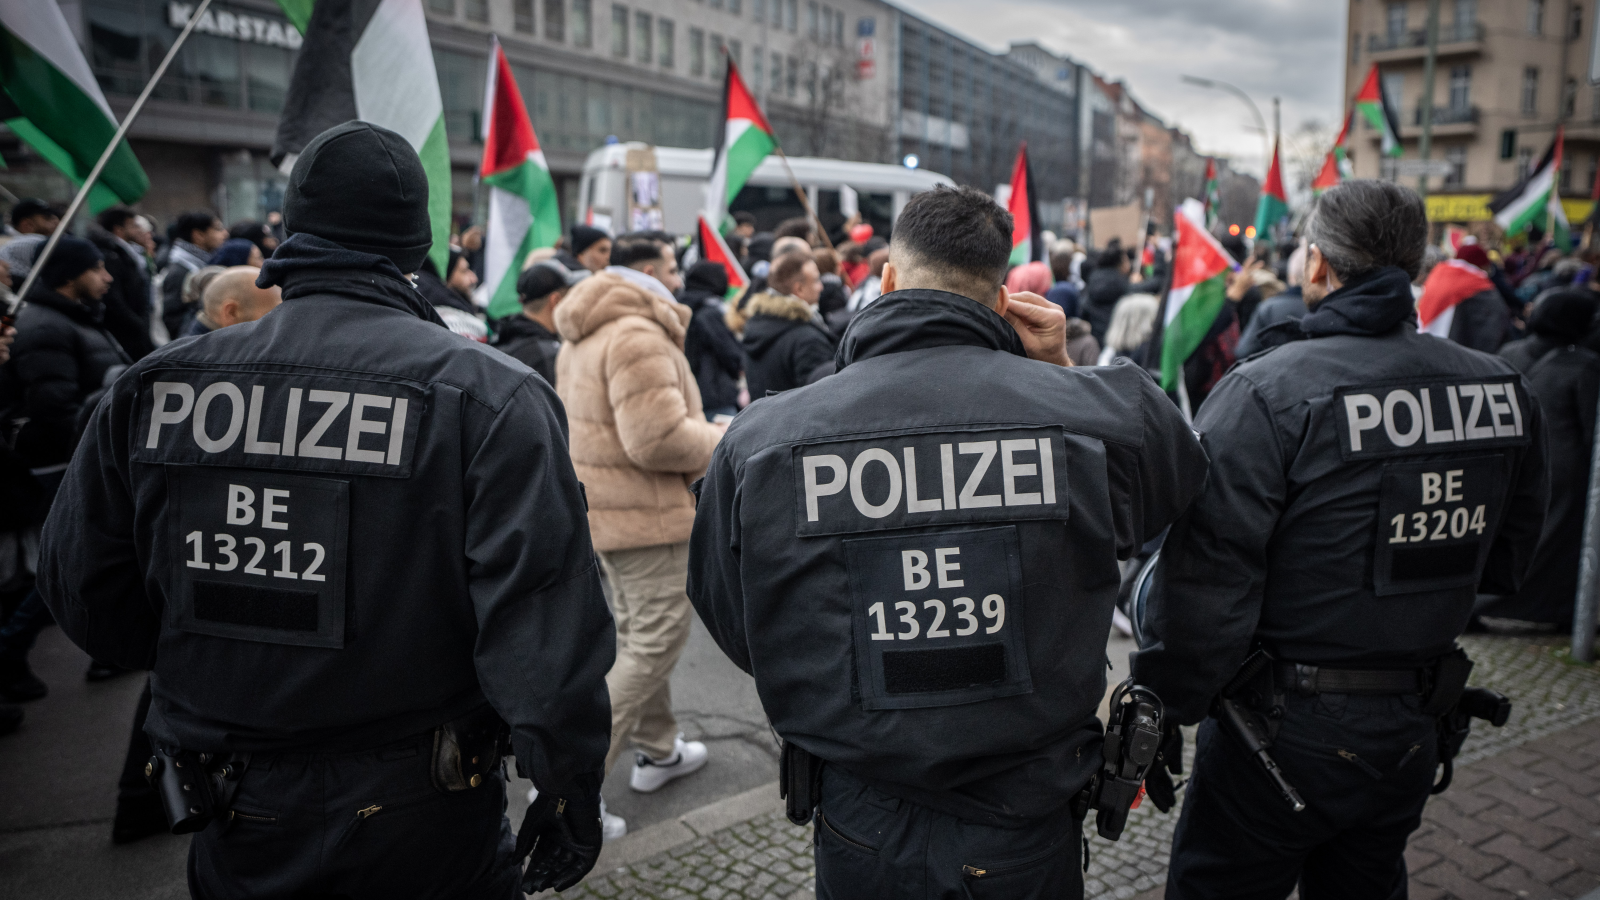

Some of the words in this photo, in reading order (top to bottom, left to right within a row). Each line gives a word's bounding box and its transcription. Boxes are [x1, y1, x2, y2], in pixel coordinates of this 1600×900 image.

[145, 381, 409, 466] POLIZEI
[1343, 382, 1524, 452] POLIZEI
[802, 437, 1057, 523] POLIZEI
[1421, 469, 1464, 505] BE
[226, 483, 290, 531] BE
[1389, 504, 1487, 544] 13204
[185, 530, 326, 582] 13212
[901, 546, 965, 591] BE
[868, 593, 1006, 641] 13239
